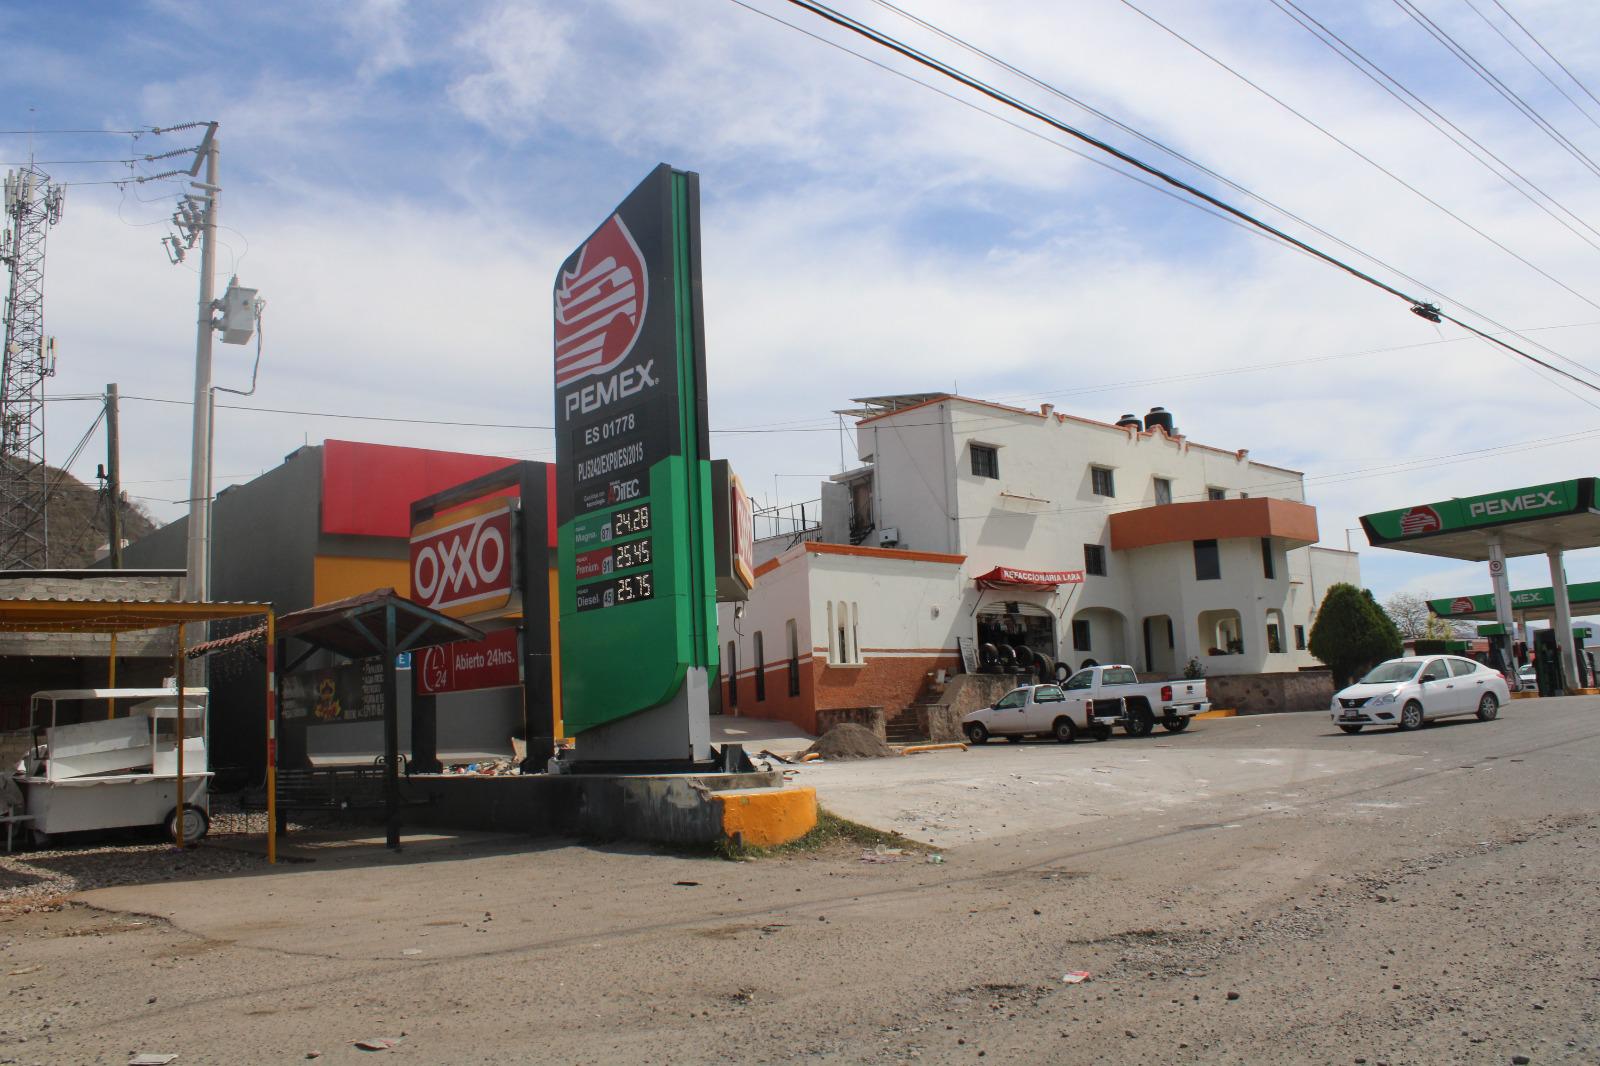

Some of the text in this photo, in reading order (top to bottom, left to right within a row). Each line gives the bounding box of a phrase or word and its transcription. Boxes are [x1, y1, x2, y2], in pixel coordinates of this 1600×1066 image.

[566, 359, 655, 421] PEMEX
[585, 413, 635, 445] ES 01778
[1469, 490, 1558, 517] PEMEX
[615, 506, 649, 535] 24.28
[414, 522, 505, 603] OXXO
[616, 540, 650, 568] 25.45
[577, 593, 599, 607] Diesel
[617, 574, 651, 601] 25.75
[455, 648, 515, 671] Abierto 24hrs.
[435, 670, 447, 688] 24
